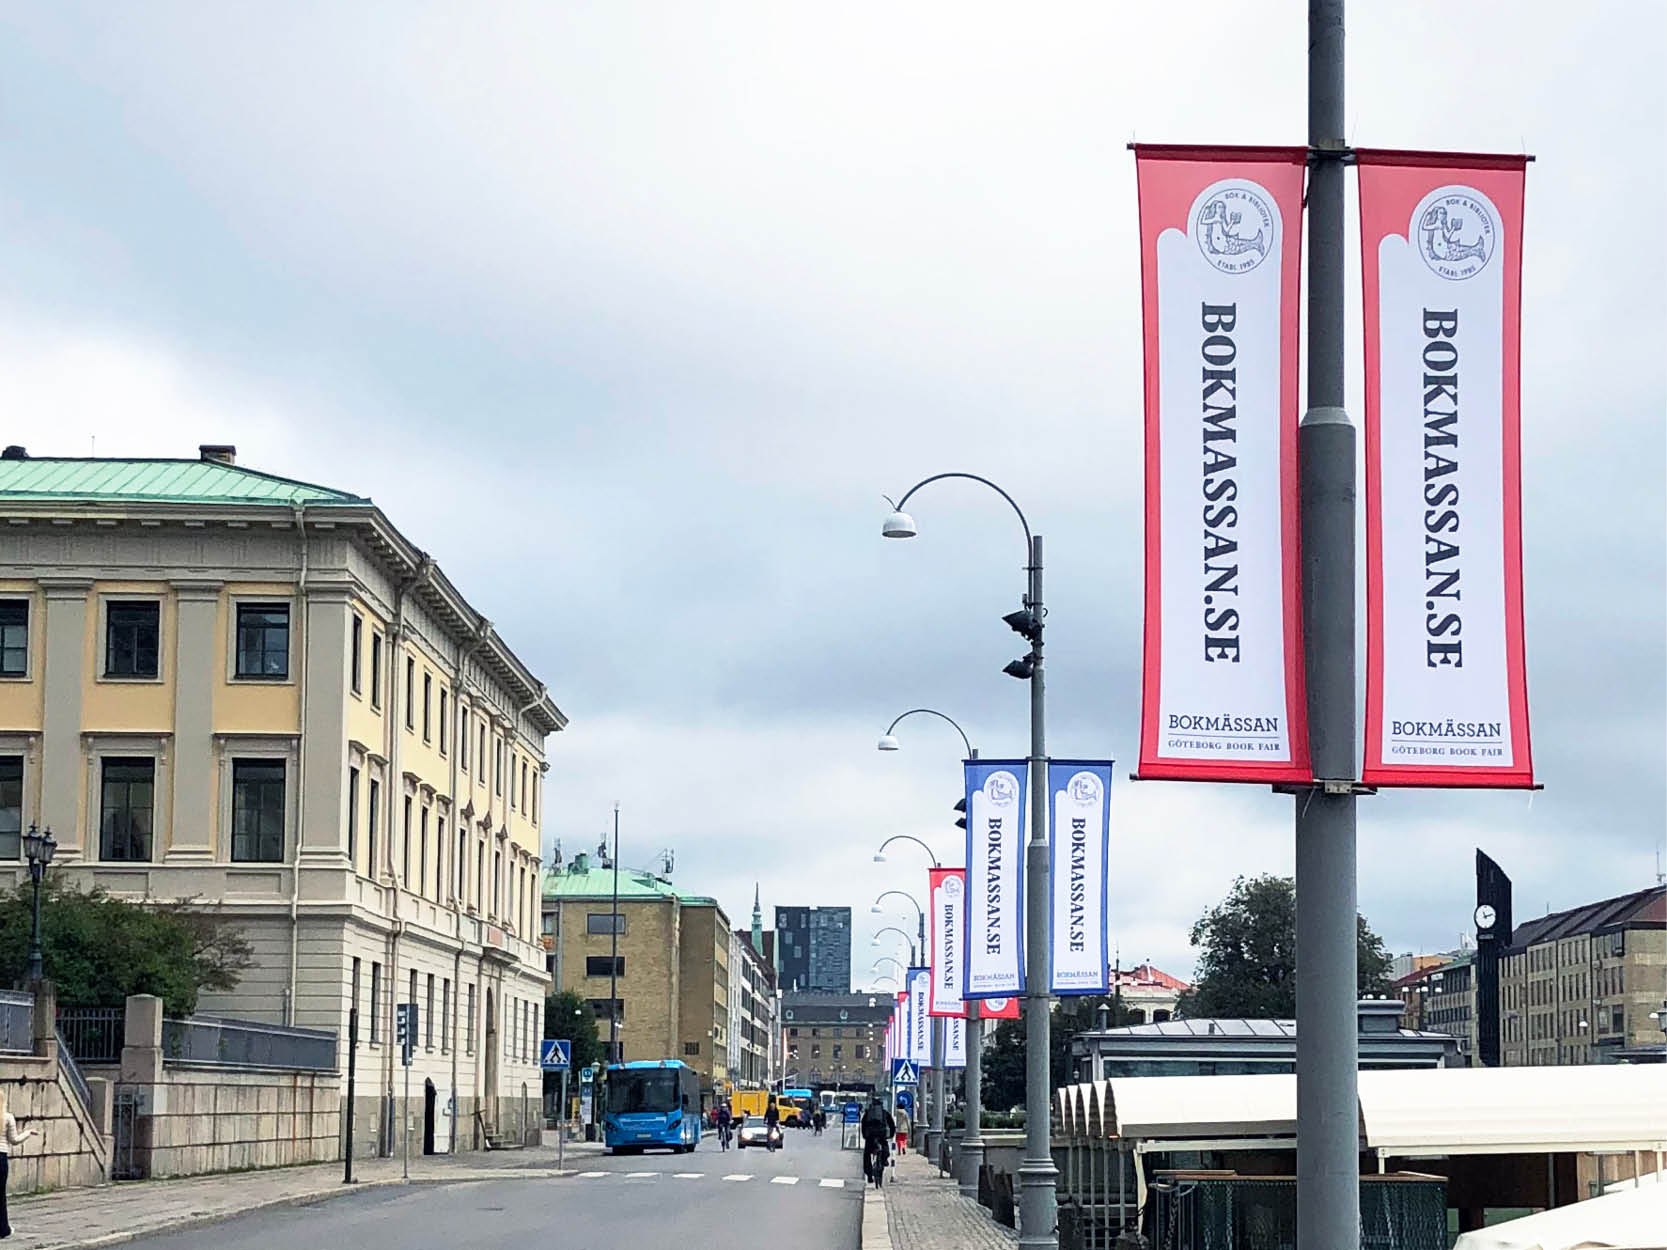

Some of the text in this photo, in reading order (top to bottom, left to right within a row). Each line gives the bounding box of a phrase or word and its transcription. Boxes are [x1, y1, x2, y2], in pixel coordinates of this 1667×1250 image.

[1201, 302, 1240, 663] BOKMASSAN.SE
[1422, 308, 1462, 668] BOKMASSAN.SE
[1168, 739, 1222, 749] GÖTEBORG
[1258, 743, 1280, 751] FAIR
[1169, 714, 1278, 732] BOKMÄSSAN
[1392, 719, 1501, 737] BOKMÄSSAN
[1392, 745, 1503, 756] GÖTEBORG BOOK FAIR
[987, 818, 1002, 955] BOKMASSAN.SE
[1070, 818, 1085, 952] BOKMASSAN.SE
[944, 904, 953, 989] BOKMASSAN.SE
